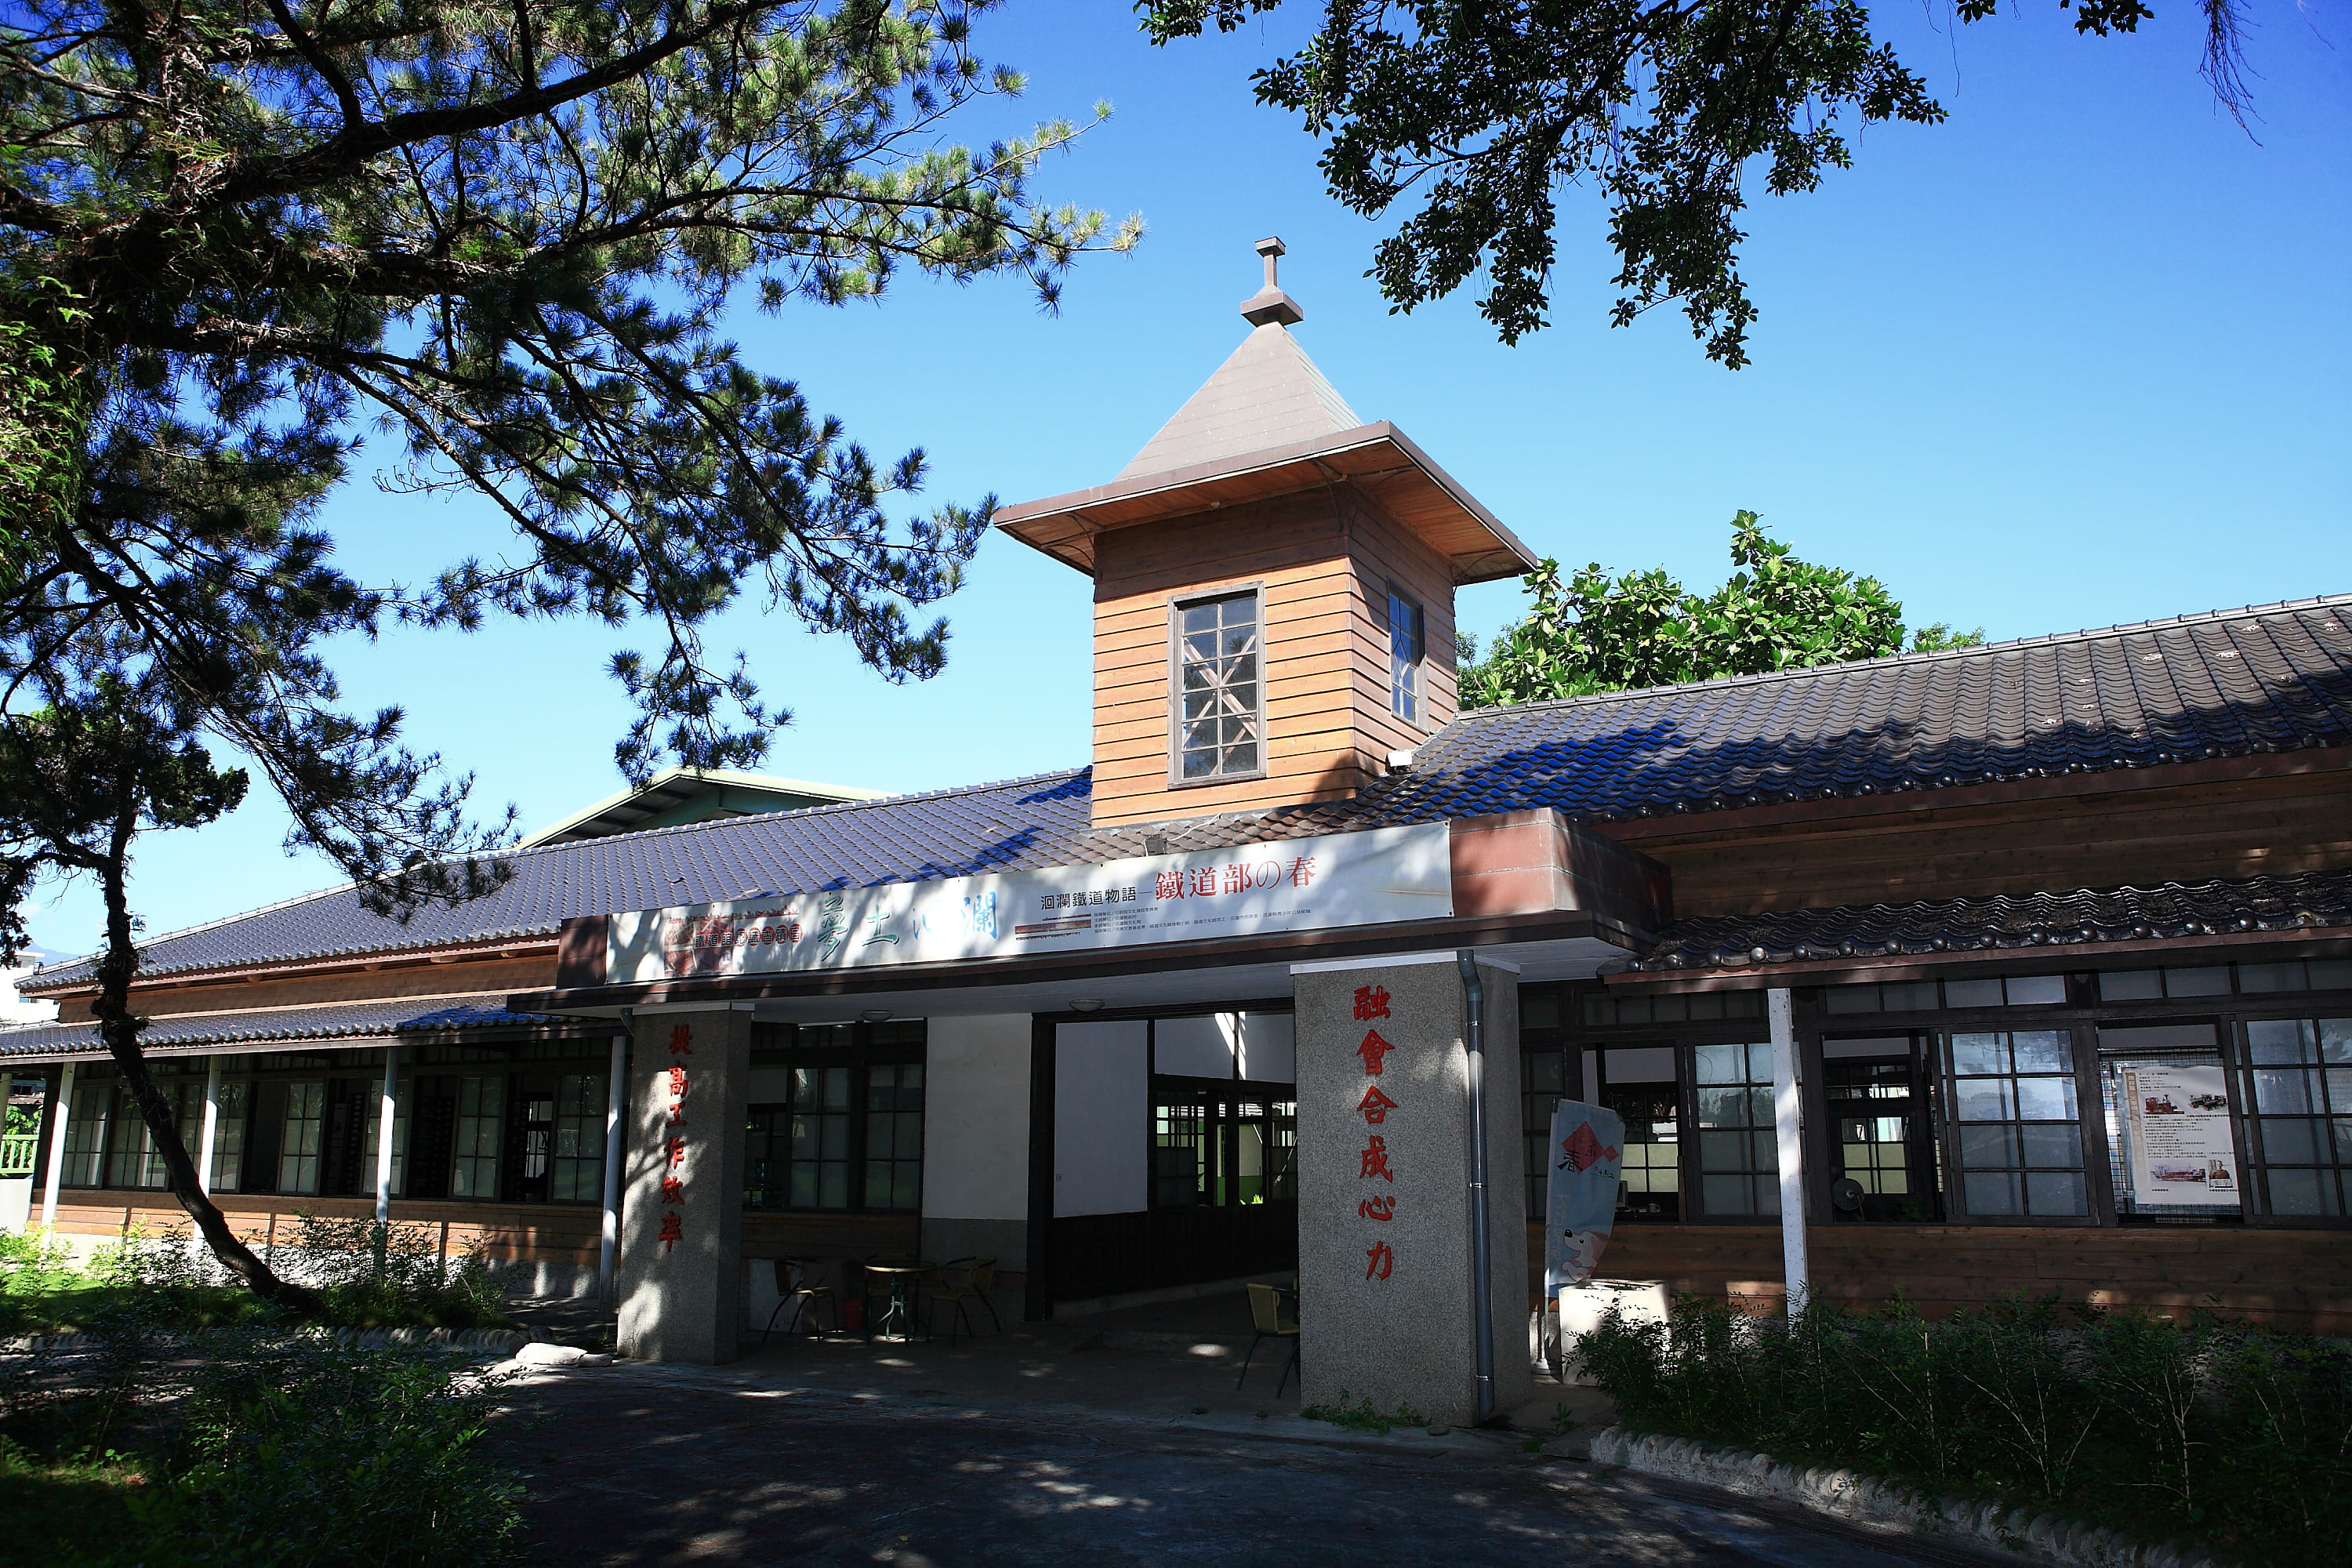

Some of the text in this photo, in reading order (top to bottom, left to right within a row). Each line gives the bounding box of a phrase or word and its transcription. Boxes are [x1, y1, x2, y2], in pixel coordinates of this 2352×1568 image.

[1155, 855, 1317, 901] 鐵道部の春
[659, 1024, 692, 1253] 提高工作效率
[1353, 985, 1398, 1281] 融會合成心力
